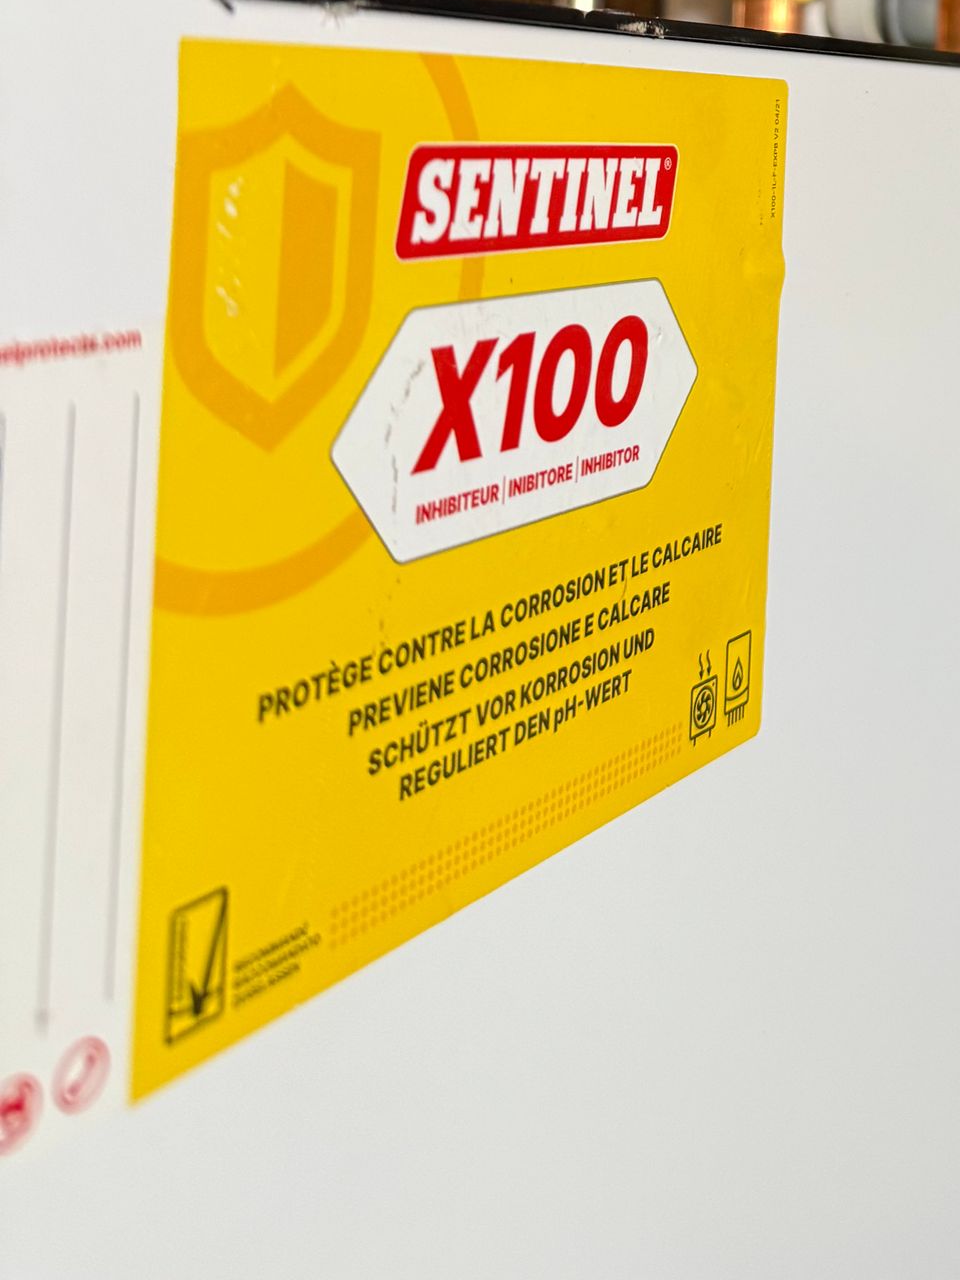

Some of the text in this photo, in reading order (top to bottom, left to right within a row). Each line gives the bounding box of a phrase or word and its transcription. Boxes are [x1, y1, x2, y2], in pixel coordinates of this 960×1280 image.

[411, 314, 649, 476] X100
[415, 444, 640, 525] INHIBITEUR INIBITORE INHIBITOR
[258, 523, 723, 723] PROTÈGE CONTRE LA CORROSION ET LE CALCAIRE
[348, 581, 671, 737] PREVIENE CORROSIONE E CALCARE
[368, 627, 655, 776] SCHÜTZT VOR KORROSION UND
[399, 669, 632, 801] REGULIERT DEN pH-WERT
